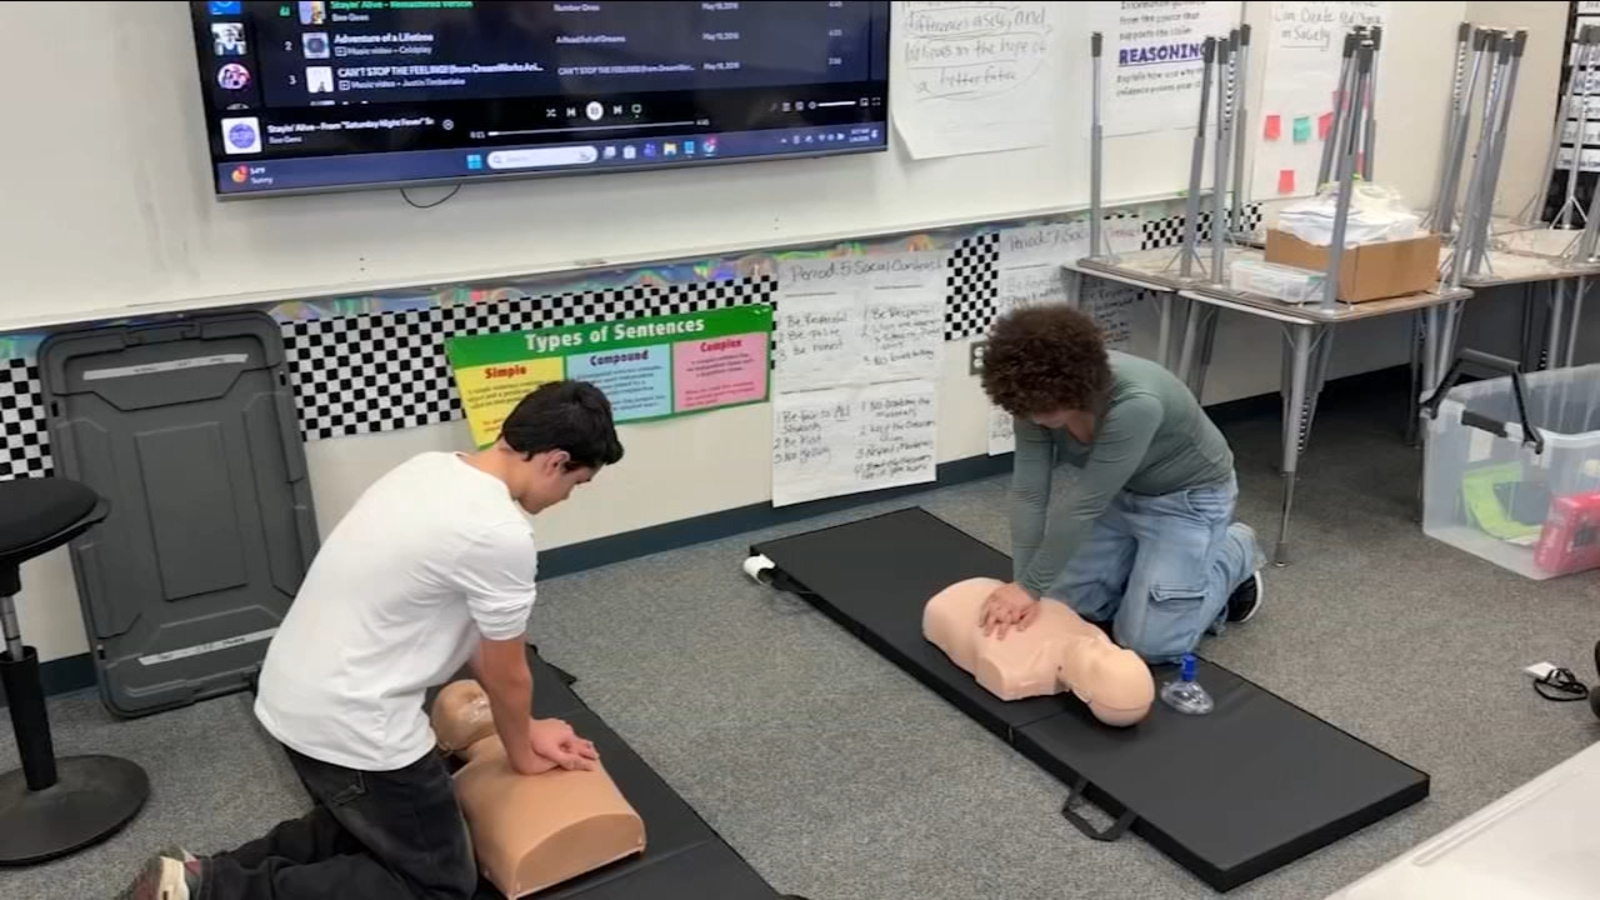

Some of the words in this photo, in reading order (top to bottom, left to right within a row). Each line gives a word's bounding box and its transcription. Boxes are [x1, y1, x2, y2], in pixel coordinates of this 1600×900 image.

[1014, 7, 1047, 29] and
[334, 34, 380, 43] Adventure
[399, 32, 434, 42] Lifetime
[284, 41, 293, 51] 2
[973, 40, 995, 57] the
[367, 67, 391, 77] STOP
[391, 66, 414, 76] THE
[289, 75, 298, 85] 3
[840, 261, 851, 276] 5
[854, 259, 891, 276] Social
[891, 257, 943, 272] Contract
[525, 331, 583, 353] Types
[589, 325, 609, 343] of
[614, 318, 706, 341] Sentences
[701, 339, 743, 354] Complex
[590, 349, 650, 367] Compound
[484, 364, 528, 380] Simple
[783, 410, 798, 423] Be
